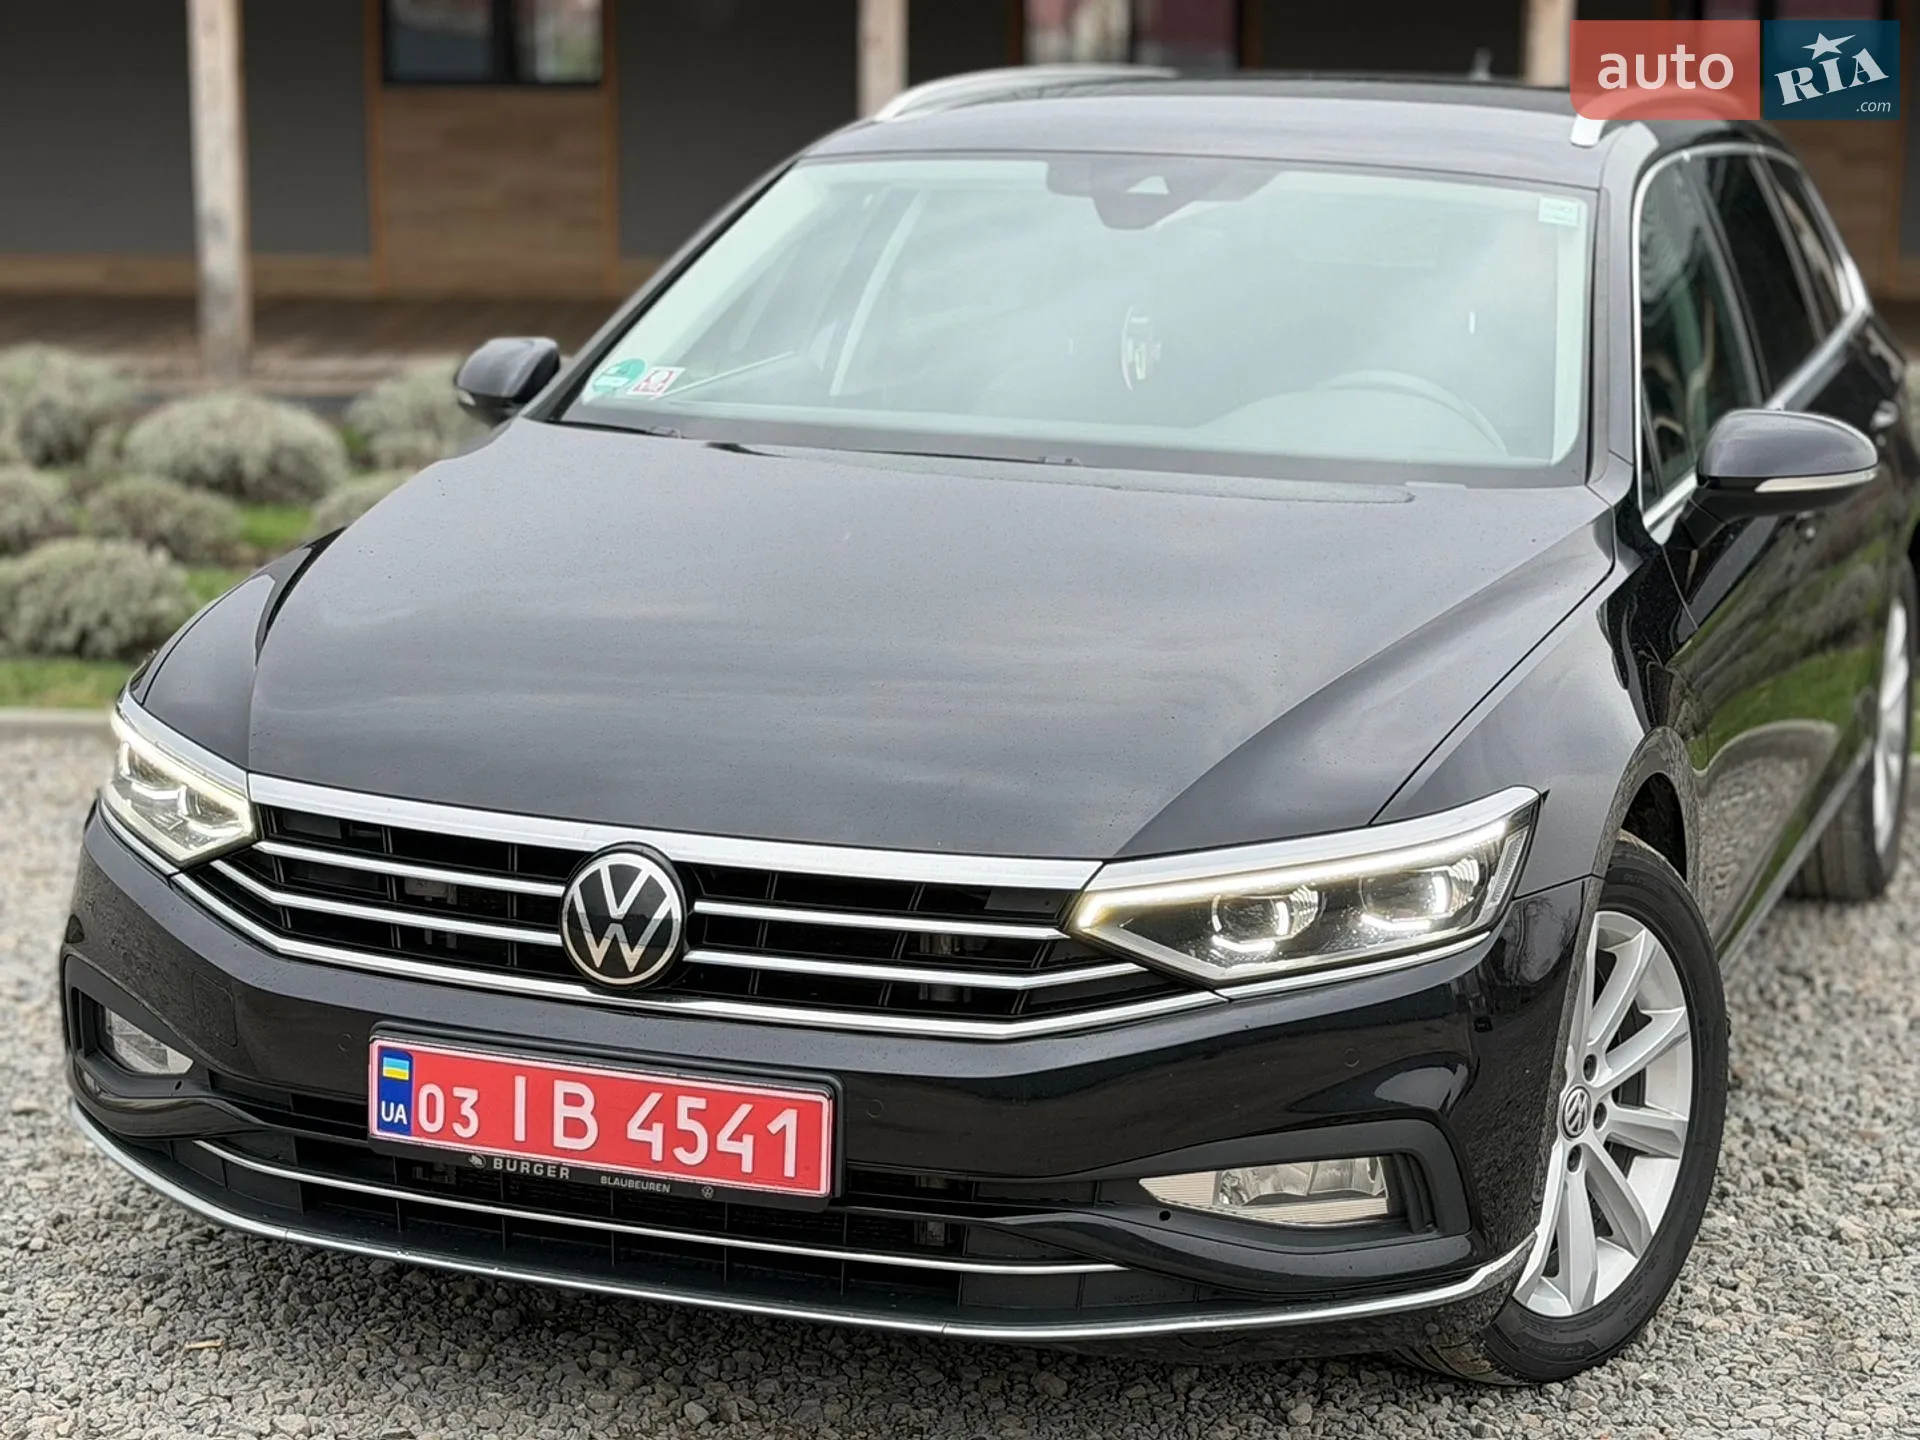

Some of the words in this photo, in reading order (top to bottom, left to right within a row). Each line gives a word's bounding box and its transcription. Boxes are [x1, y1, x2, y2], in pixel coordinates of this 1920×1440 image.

[381, 1100, 408, 1125] UA
[418, 1083, 479, 1138] 03
[514, 1075, 599, 1150] IB
[627, 1092, 798, 1178] 4541
[493, 1157, 570, 1180] BURGER
[600, 1175, 671, 1194] BLAUBEUREN
